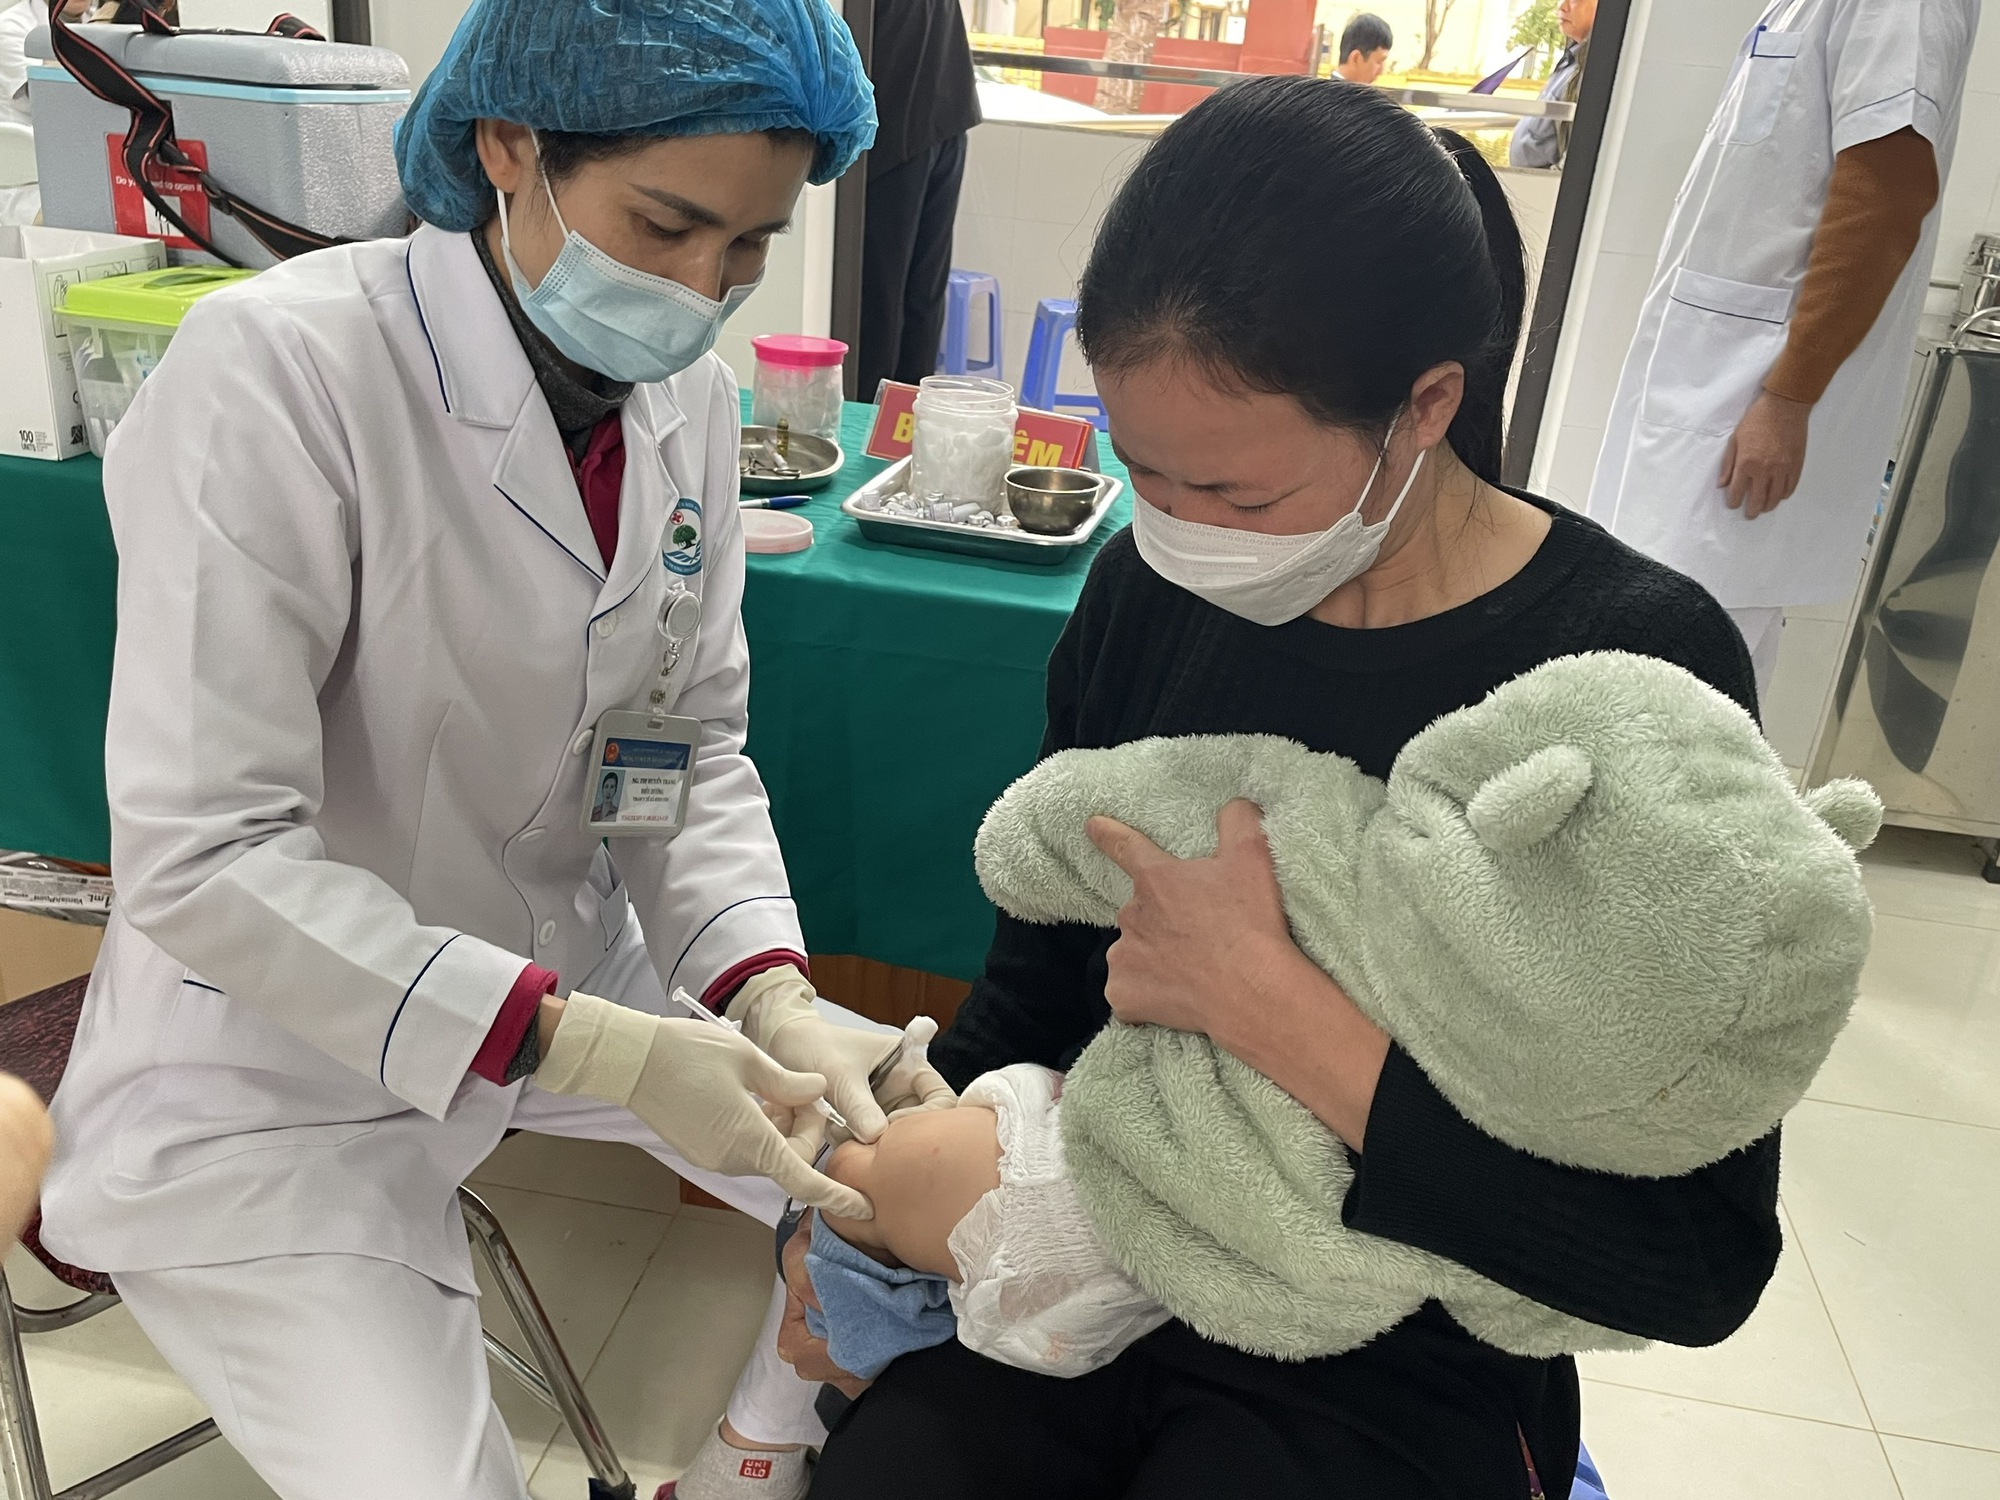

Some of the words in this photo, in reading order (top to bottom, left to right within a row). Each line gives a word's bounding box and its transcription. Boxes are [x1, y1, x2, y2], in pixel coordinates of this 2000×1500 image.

[115, 175, 127, 185] Do
[174, 183, 195, 193] open
[19, 429, 34, 444] 100
[1012, 429, 1064, 468] ÊM
[746, 1460, 767, 1468] UNI
[744, 1467, 766, 1477] QLO
